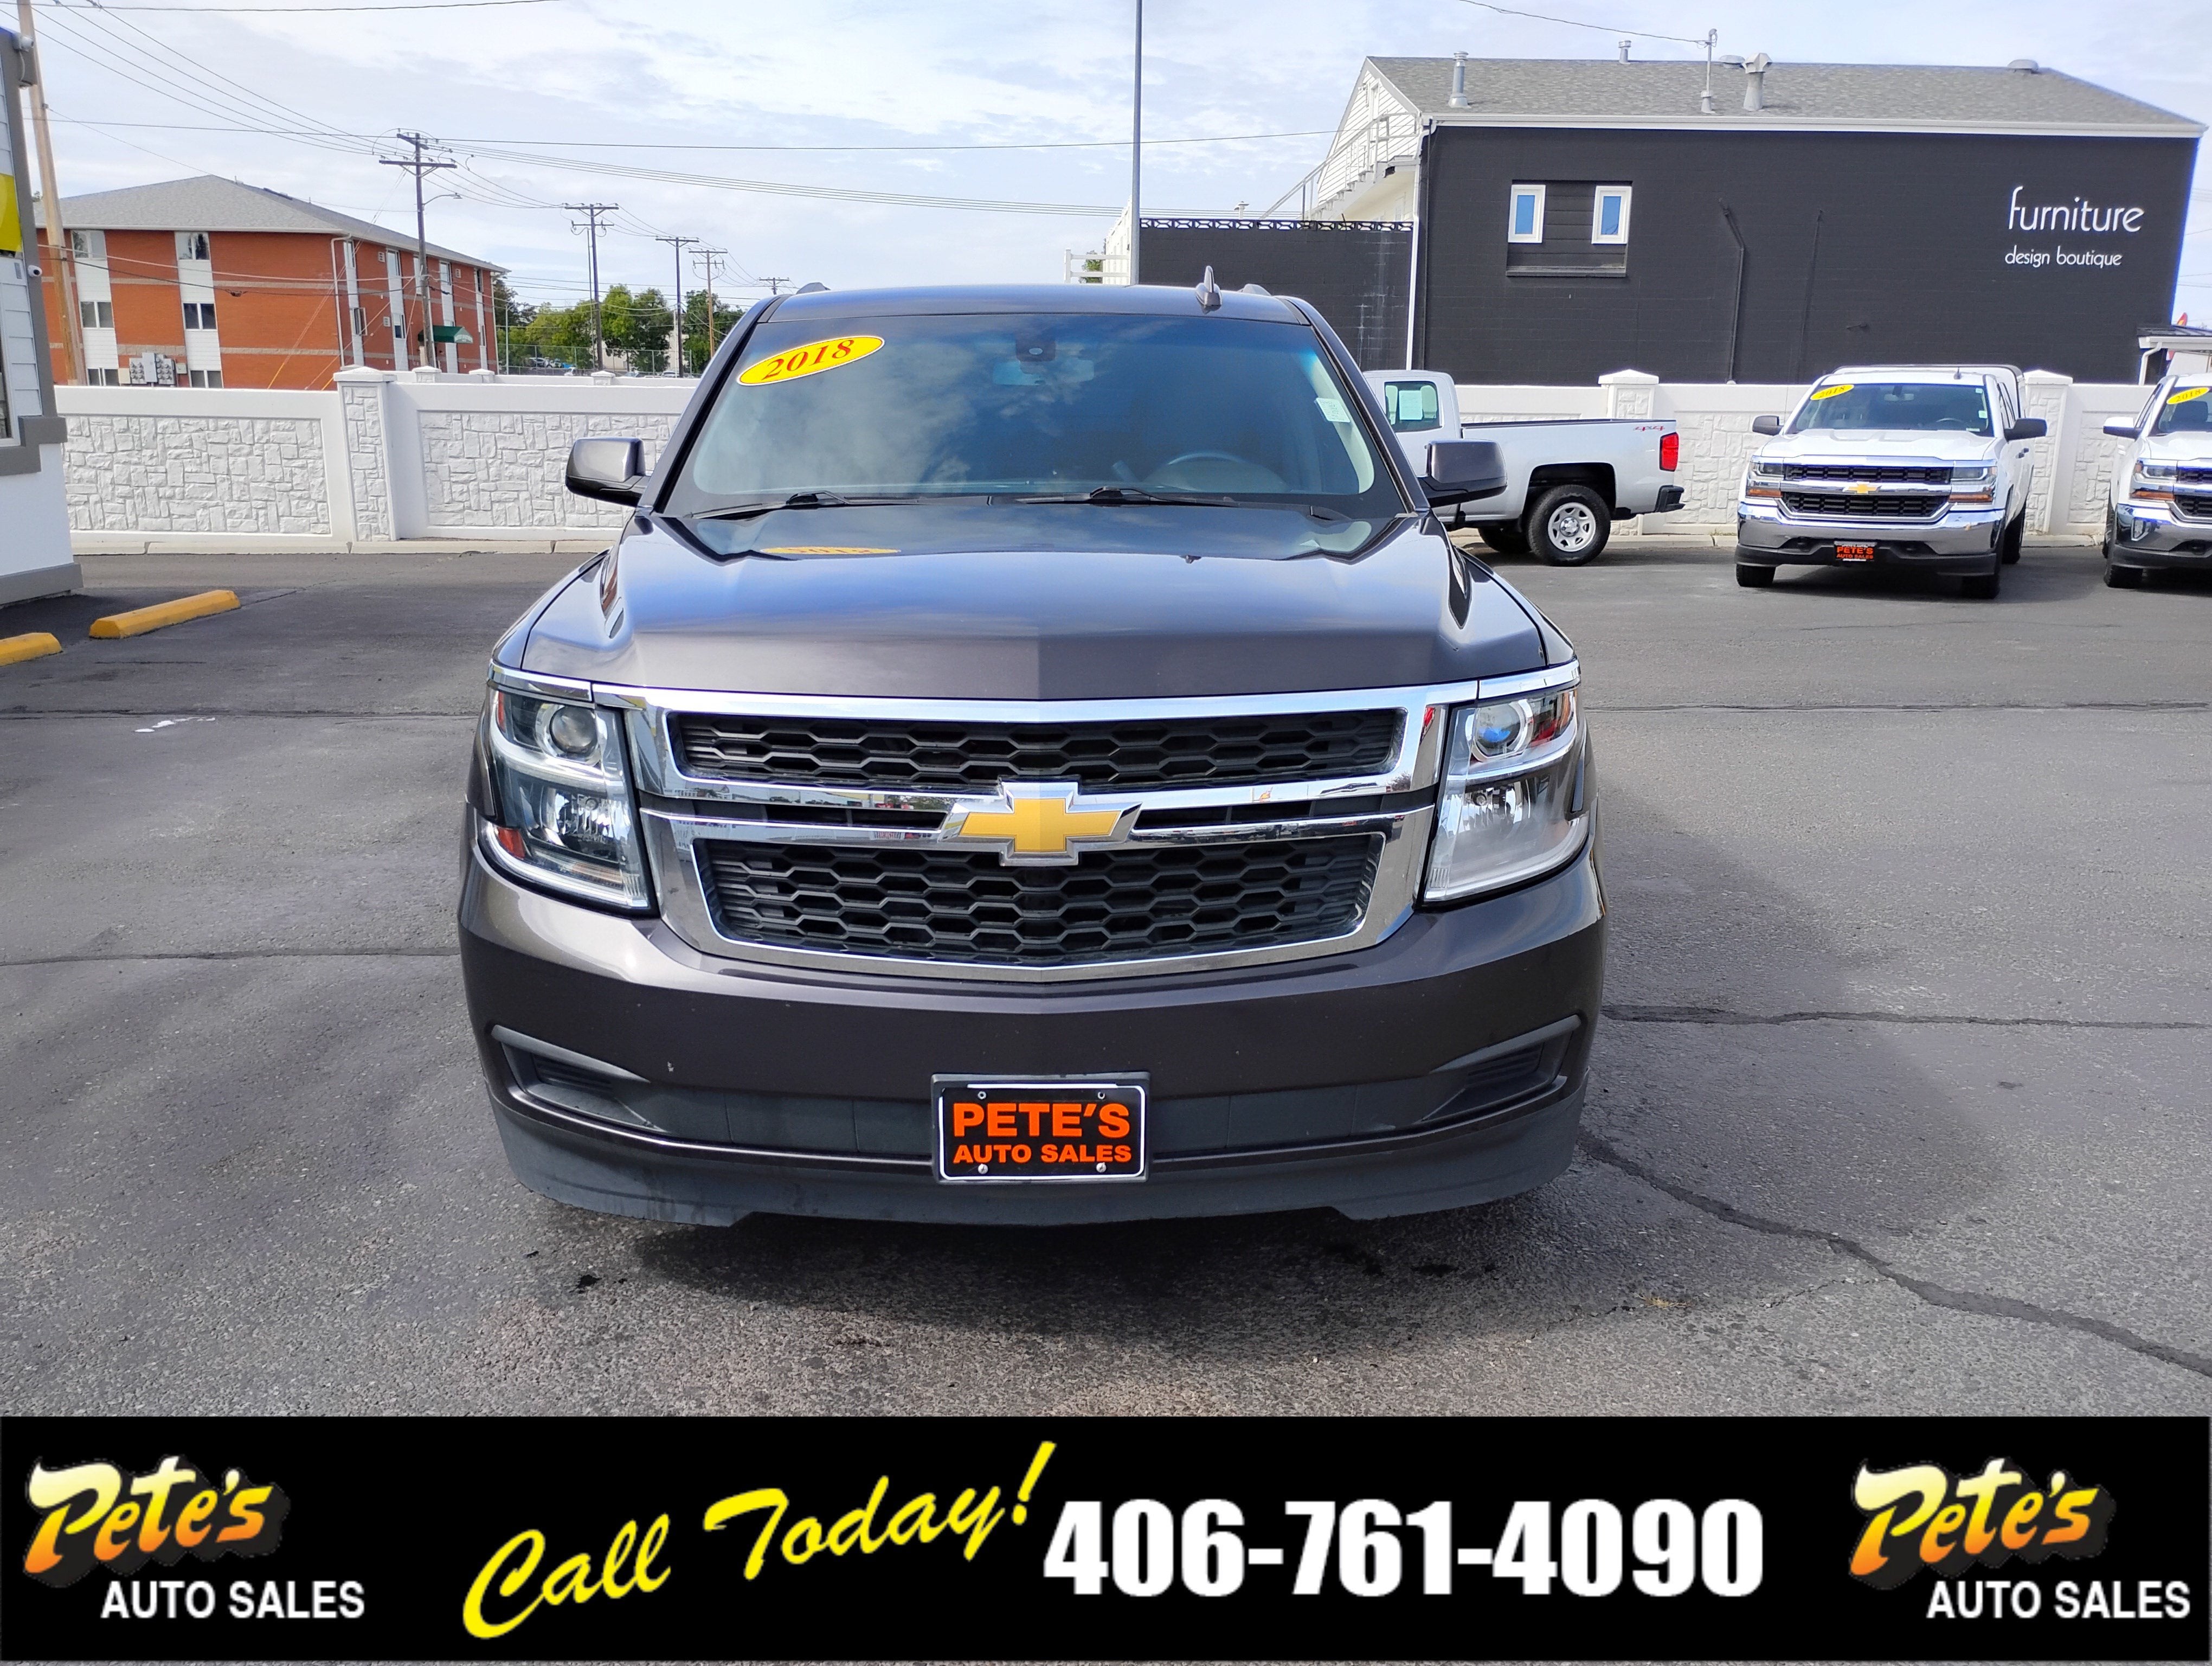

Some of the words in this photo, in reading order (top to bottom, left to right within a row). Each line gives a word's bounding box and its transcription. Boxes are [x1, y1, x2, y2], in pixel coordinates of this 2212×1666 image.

[2008, 185, 2145, 232] furniture
[2004, 244, 2050, 268] design
[2056, 245, 2124, 269] boutique
[761, 339, 854, 381] 2018
[2176, 389, 2201, 402] 2018
[1836, 546, 1874, 554] PETE'S
[953, 1102, 1130, 1138] PETE'S
[953, 1144, 1032, 1164] AUTO
[1040, 1143, 1132, 1163] SALES
